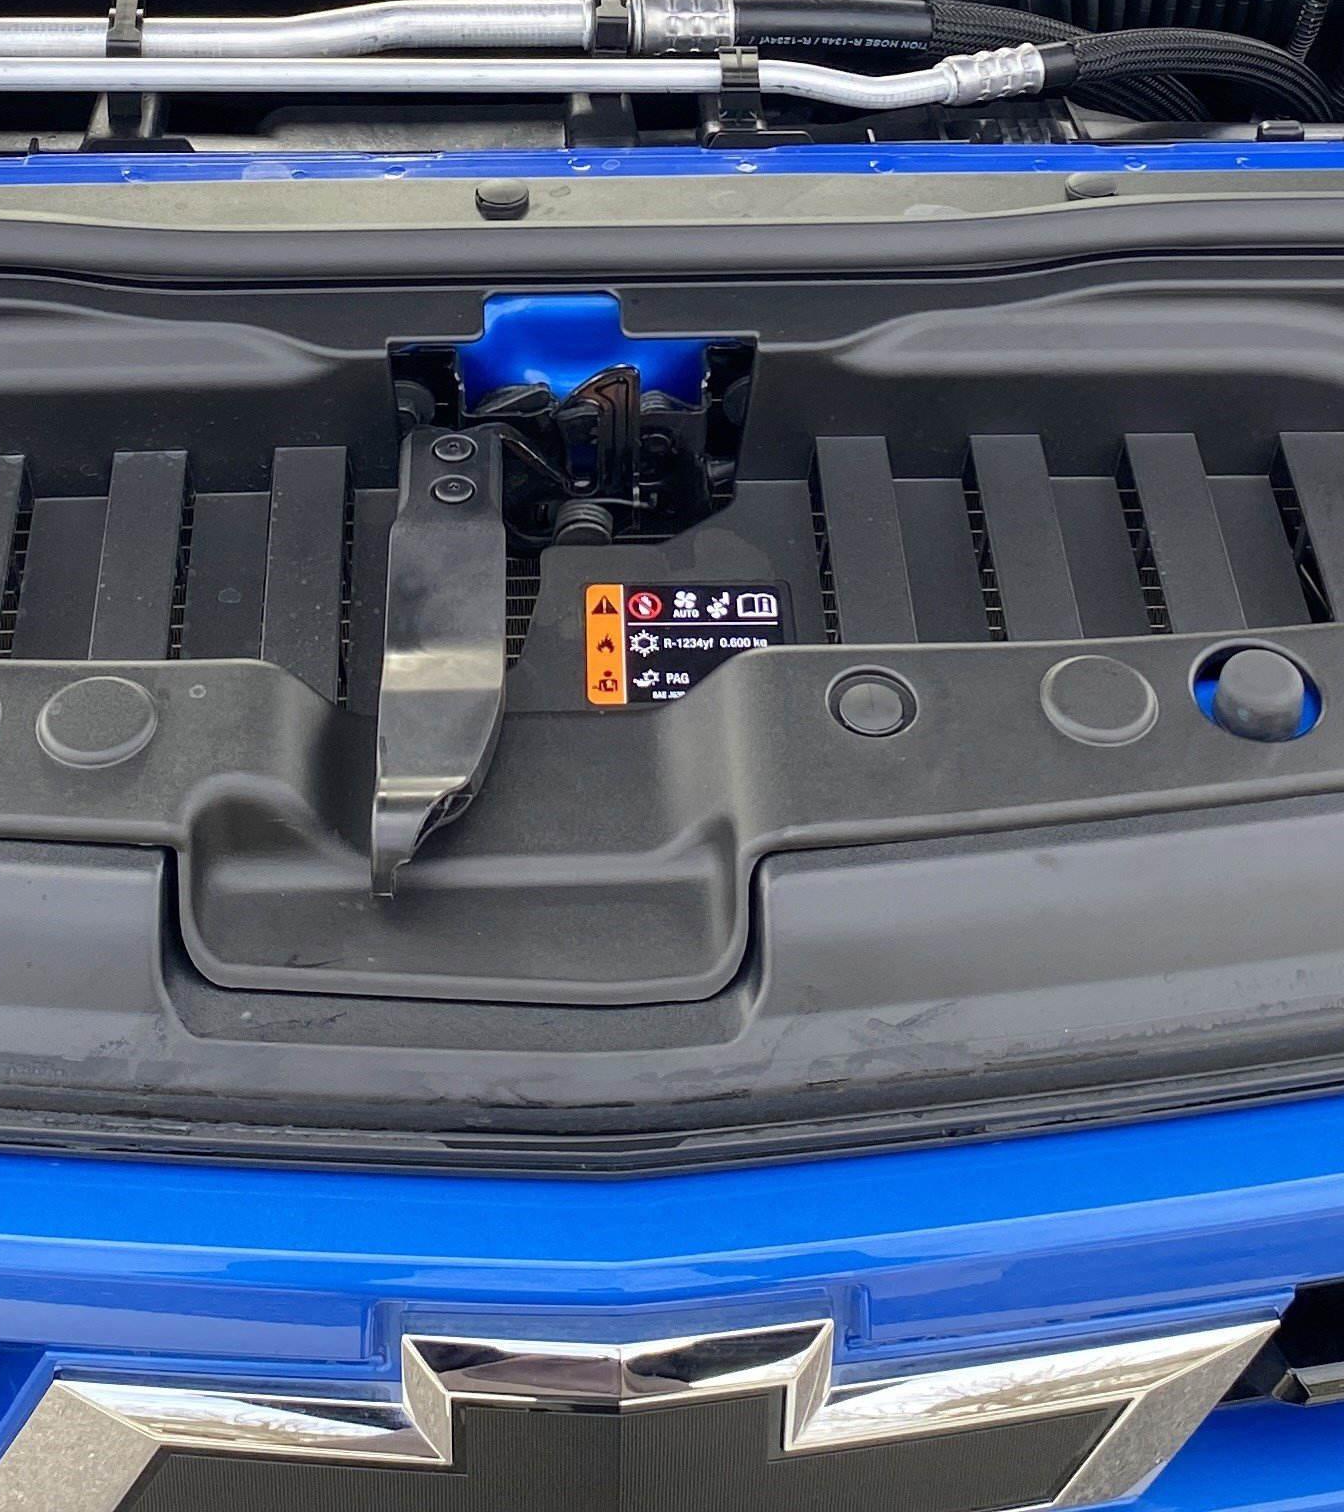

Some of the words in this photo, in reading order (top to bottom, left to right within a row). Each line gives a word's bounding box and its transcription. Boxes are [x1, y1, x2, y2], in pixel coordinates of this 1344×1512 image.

[821, 37, 863, 47] R-134a
[865, 38, 900, 49] HOSE
[900, 40, 928, 51] TION
[672, 609, 699, 619] AUTO
[663, 638, 713, 649] R-1234yf
[719, 637, 751, 648] 0.600
[665, 672, 690, 685] PAG
